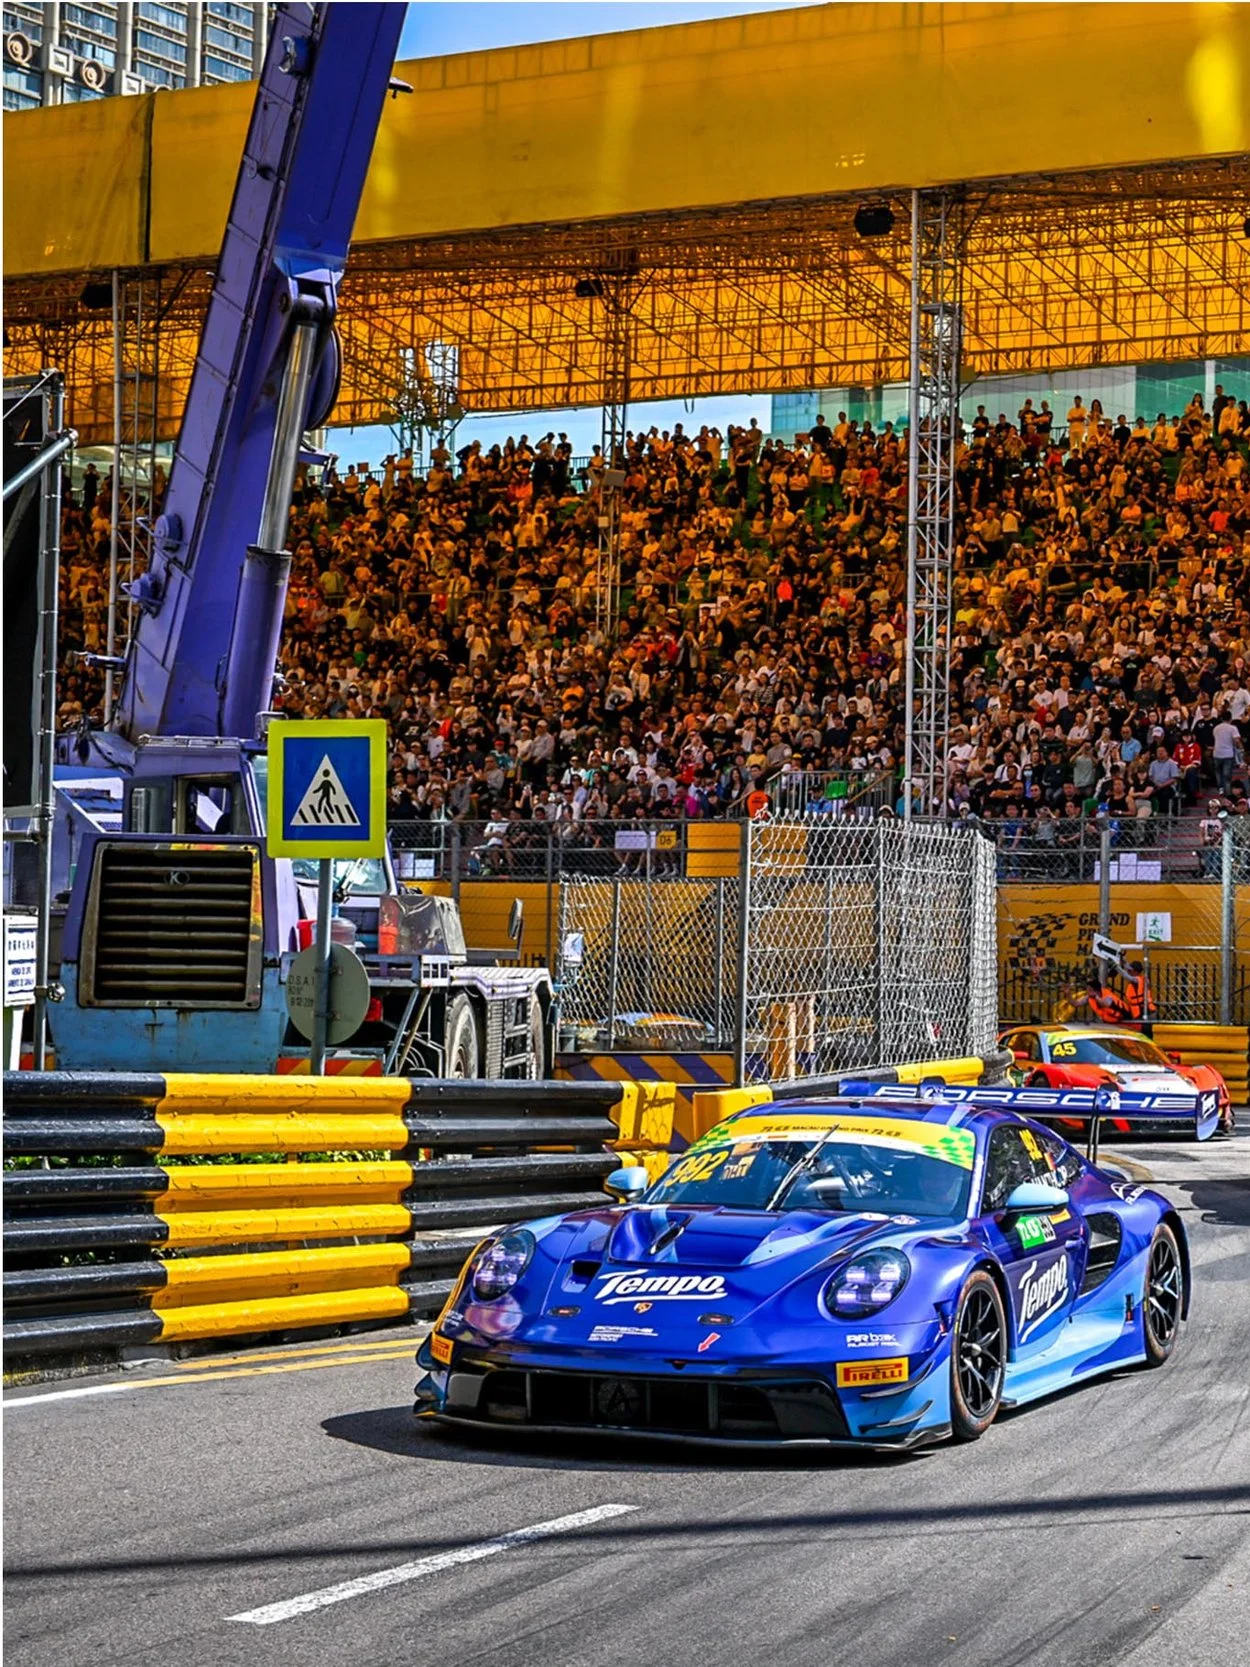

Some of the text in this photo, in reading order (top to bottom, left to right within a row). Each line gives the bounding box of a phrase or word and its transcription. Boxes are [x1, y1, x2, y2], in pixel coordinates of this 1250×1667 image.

[1079, 912, 1130, 926] GRND
[1052, 1042, 1077, 1057] 45
[664, 1151, 730, 1187] 992
[843, 1362, 903, 1382] PIRELLI
